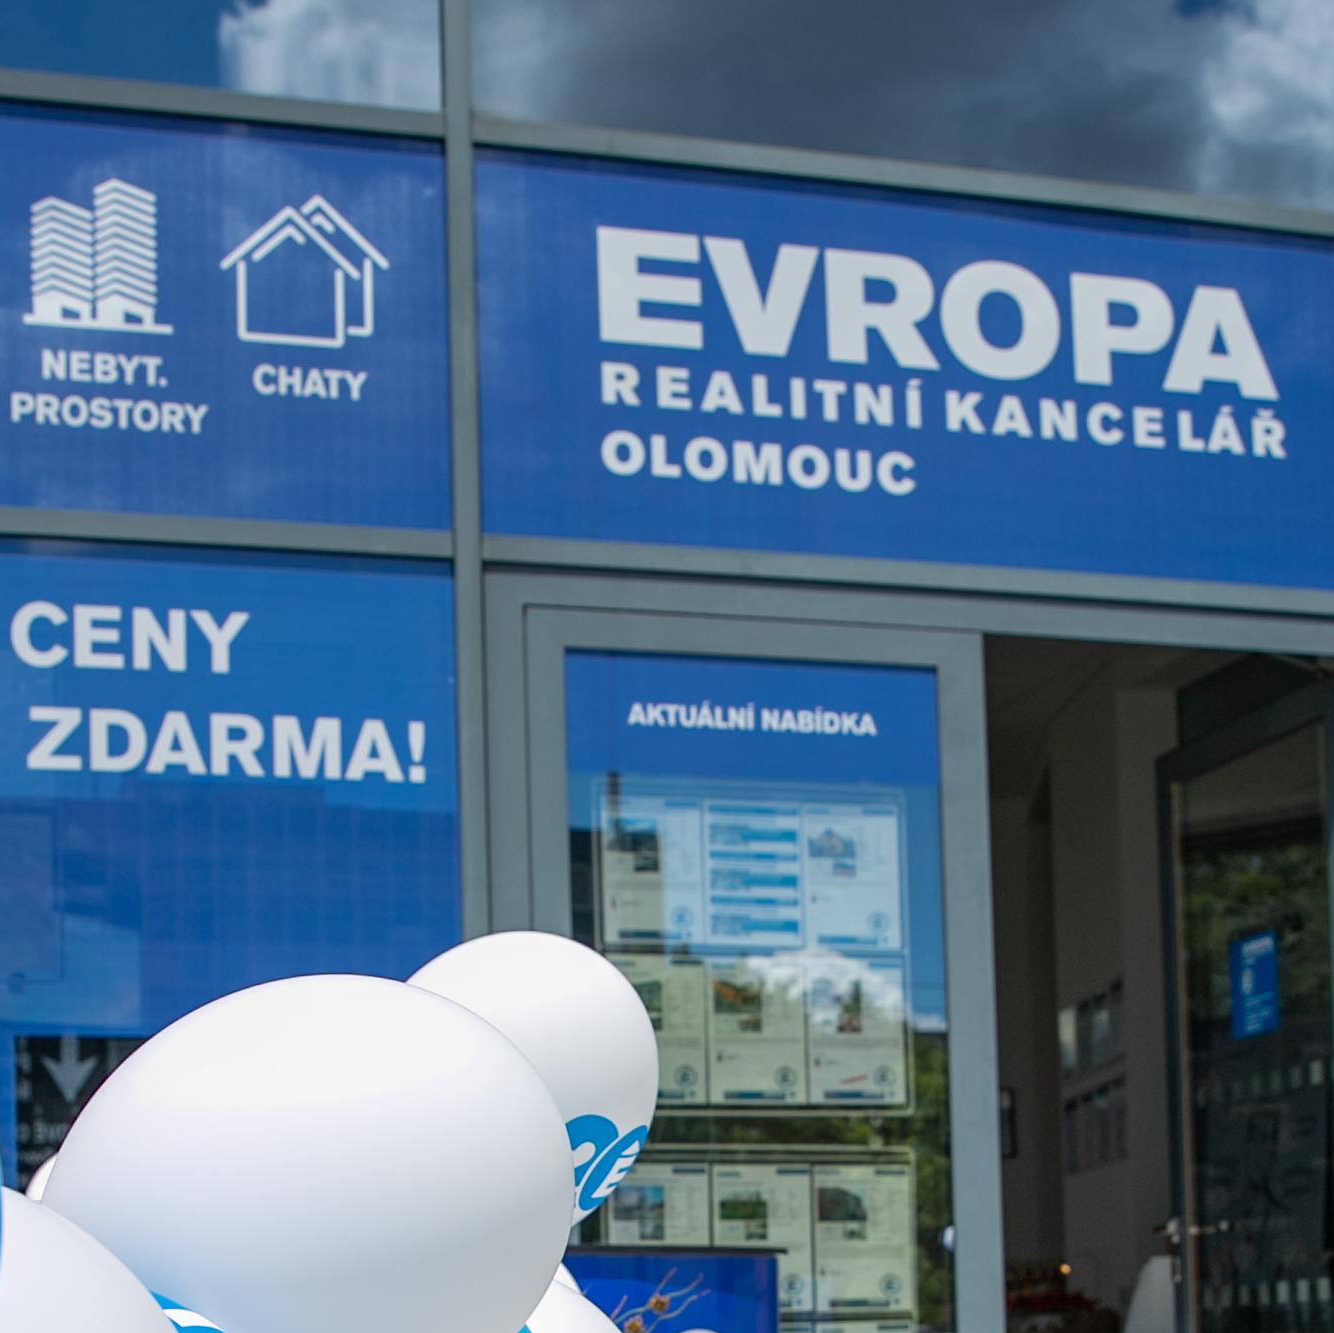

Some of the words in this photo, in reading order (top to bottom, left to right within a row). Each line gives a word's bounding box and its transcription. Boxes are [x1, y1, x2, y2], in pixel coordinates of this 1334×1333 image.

[596, 225, 1280, 401] EVROPA
[40, 347, 168, 388] NEBYT.
[252, 363, 368, 401] CHATY
[10, 391, 209, 434] PROSTORY
[601, 361, 924, 430] REALITNÍ
[945, 391, 1288, 460] KANCELÁŘ
[600, 430, 918, 496] OLOMOUC
[10, 600, 250, 674] CENY
[26, 705, 426, 784] ZDARMA!
[628, 700, 755, 730] AKTUÁLNÍ
[761, 706, 878, 736] NABÍDKA
